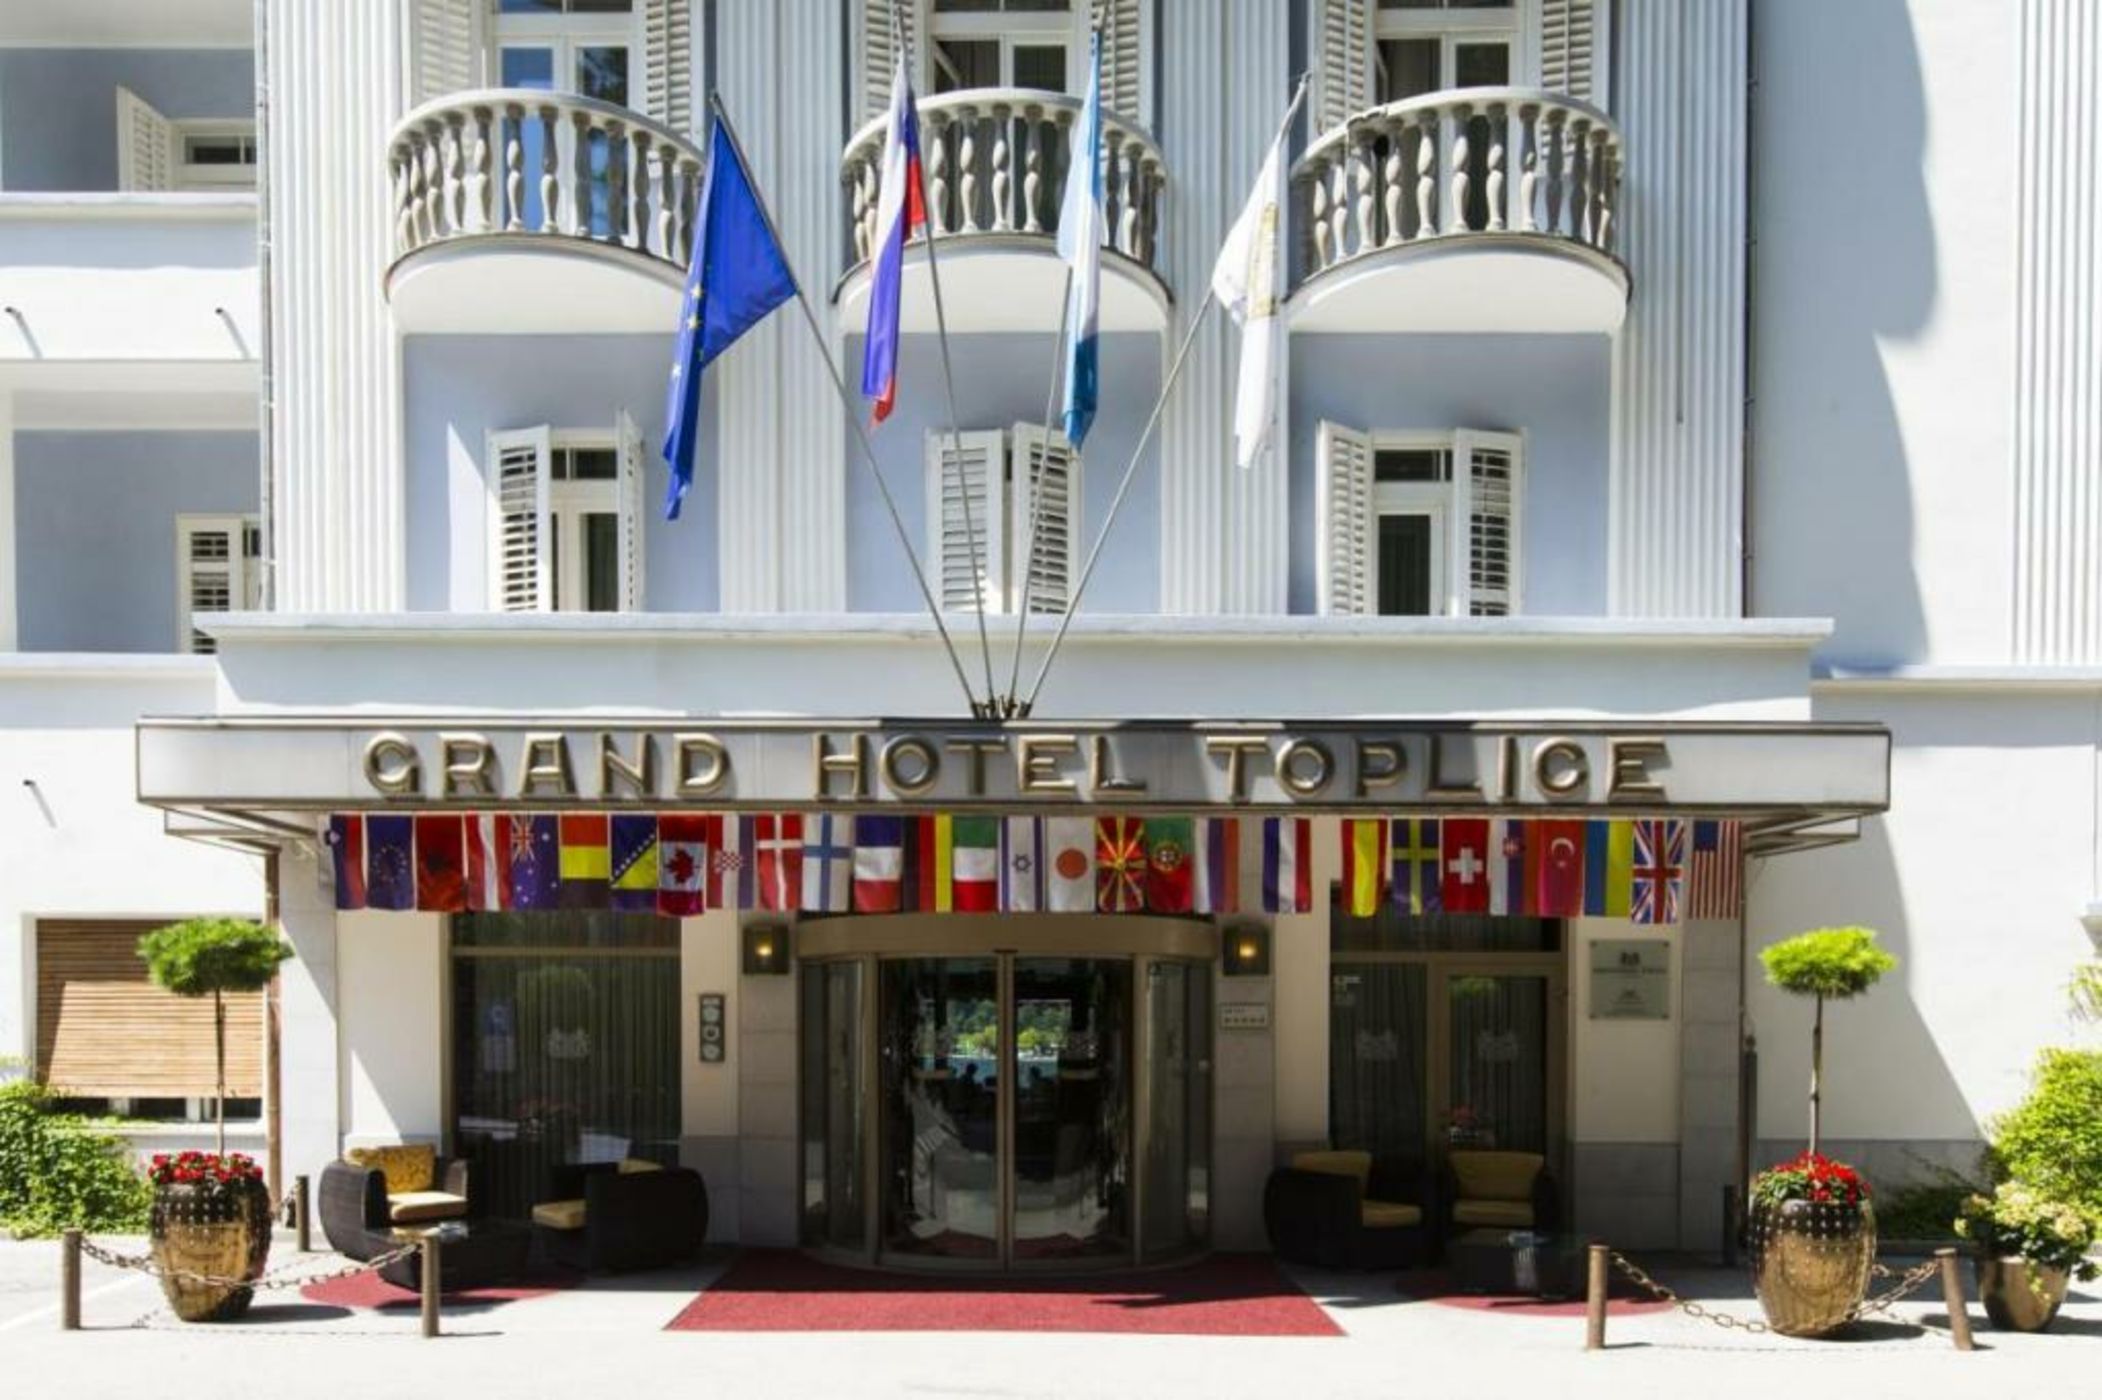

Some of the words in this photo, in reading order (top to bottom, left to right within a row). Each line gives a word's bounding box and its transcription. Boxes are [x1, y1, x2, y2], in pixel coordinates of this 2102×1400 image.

[363, 731, 732, 798] GRAND
[817, 733, 1148, 798] HOTEL
[1206, 735, 1668, 802] TOPLICE
